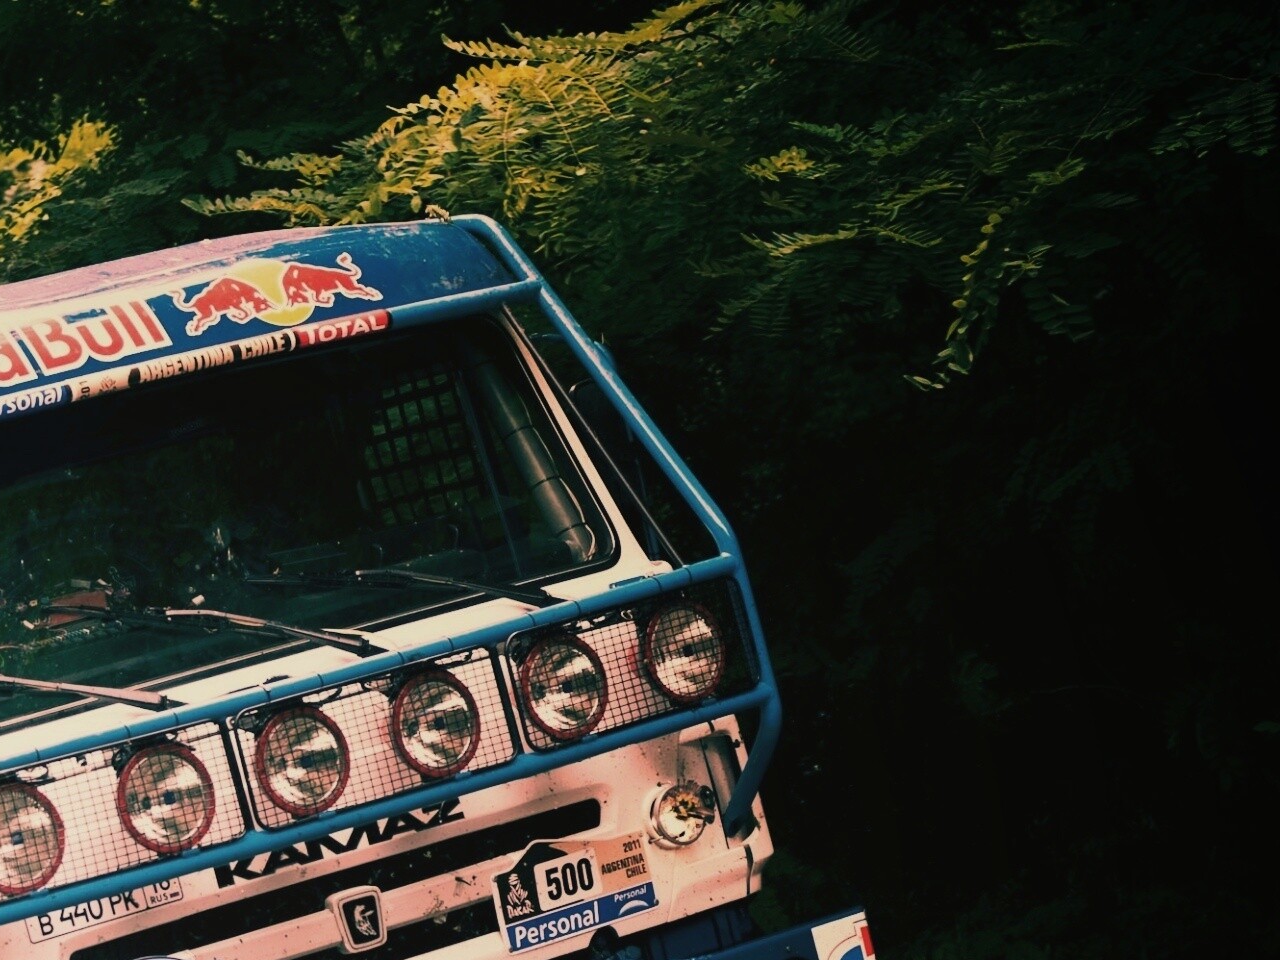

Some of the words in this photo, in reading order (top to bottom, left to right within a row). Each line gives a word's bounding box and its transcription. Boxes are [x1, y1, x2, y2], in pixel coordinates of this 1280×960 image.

[21, 301, 164, 369] Bull
[307, 315, 387, 345] TOTAL
[139, 346, 235, 383] ARGENTINA
[241, 333, 287, 361] CHILE
[623, 838, 641, 853] 2011
[601, 853, 645, 876] ARGENTINA
[626, 864, 648, 879] CHILE
[545, 857, 594, 900] 500
[150, 894, 168, 904] RUS
[614, 884, 647, 903] Personal
[514, 901, 600, 948] Personal
